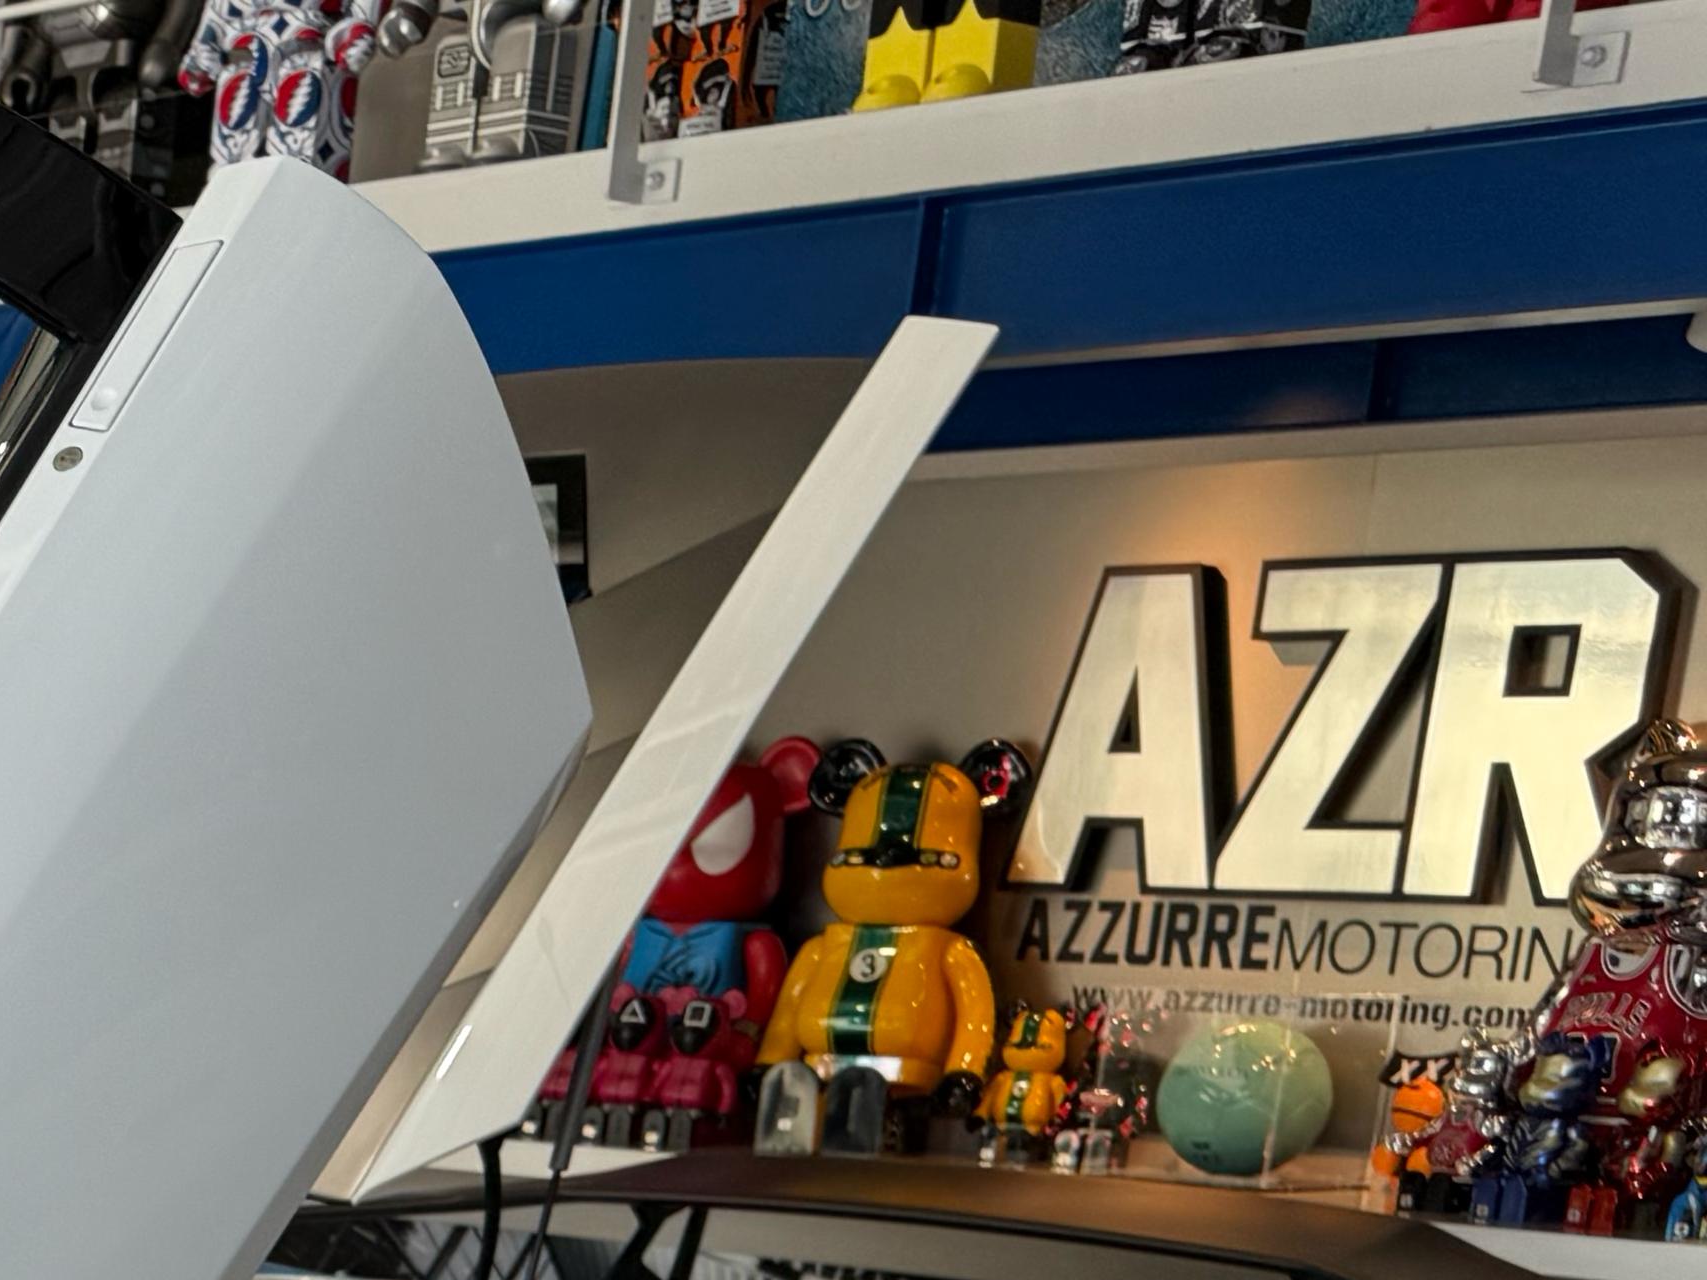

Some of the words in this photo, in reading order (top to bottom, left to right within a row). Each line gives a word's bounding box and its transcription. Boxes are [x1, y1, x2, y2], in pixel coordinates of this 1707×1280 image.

[1005, 547, 1672, 907] AZR
[861, 953, 876, 978] 3
[1016, 898, 1574, 986] AZZURREMOTORIN
